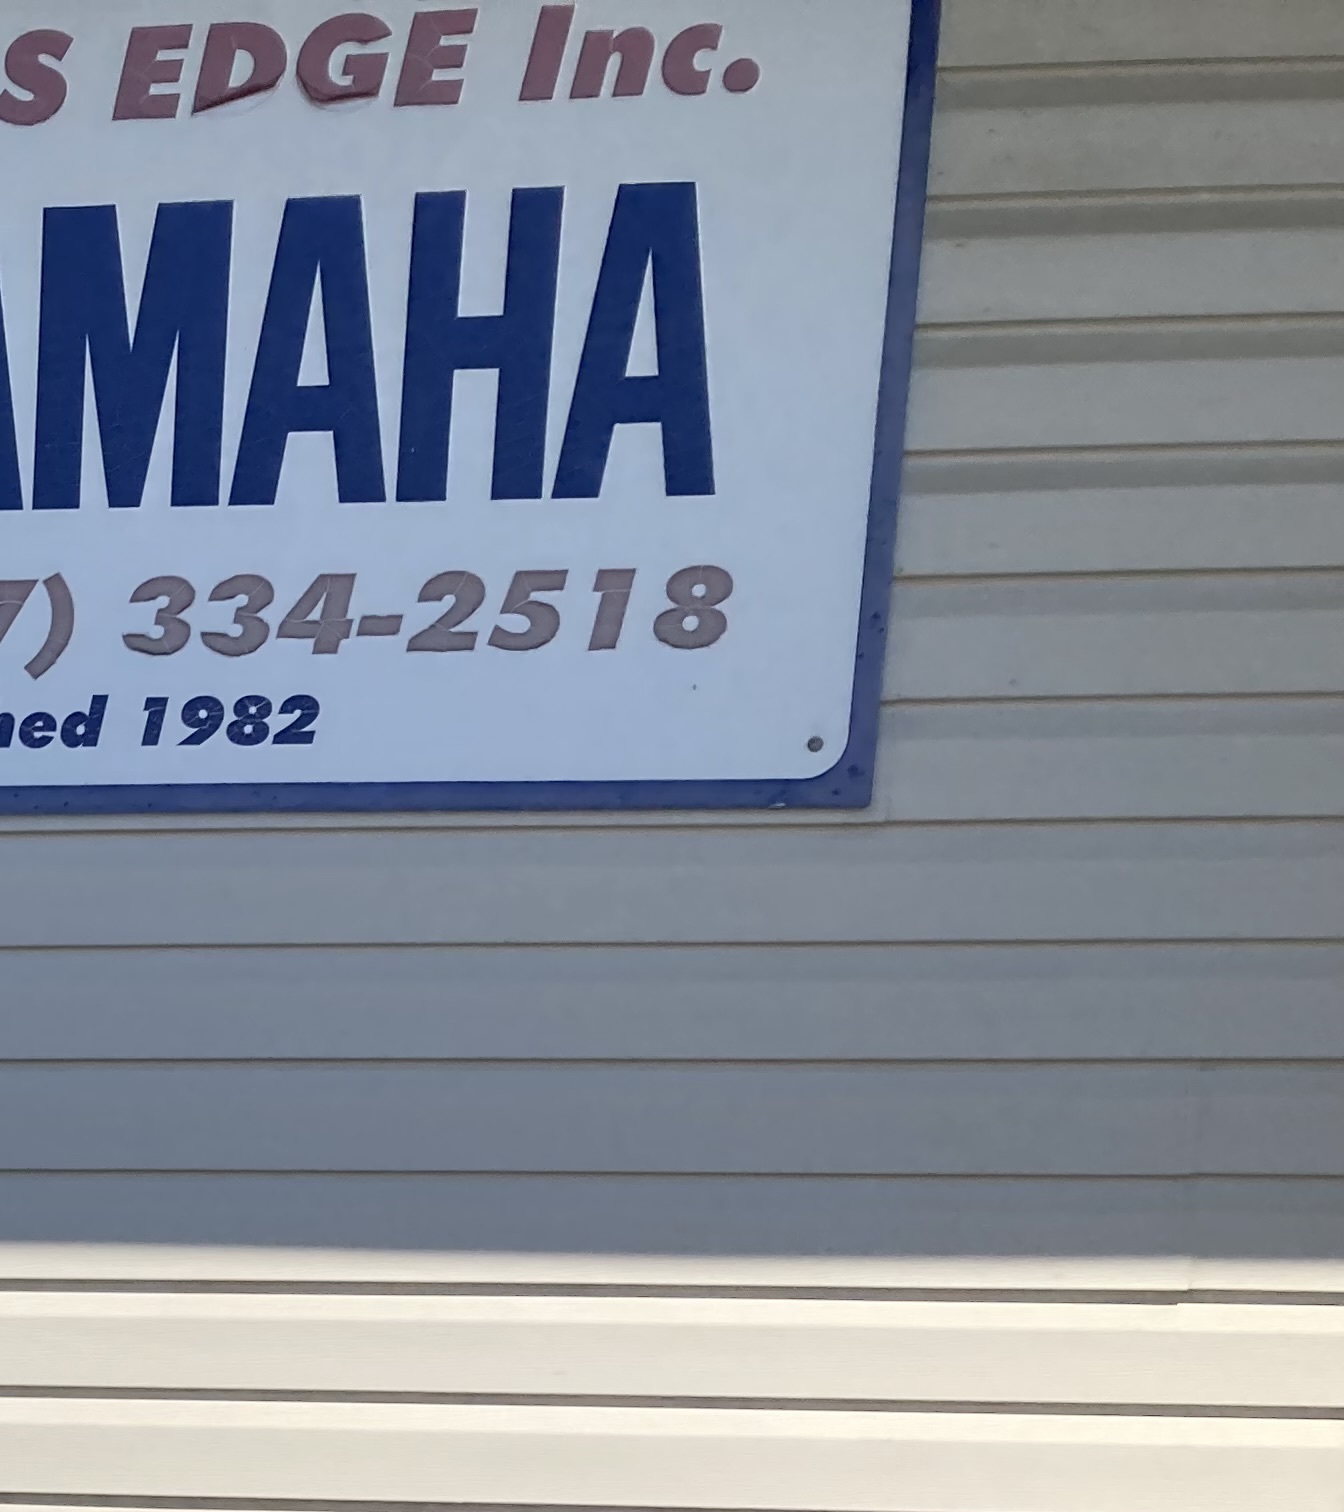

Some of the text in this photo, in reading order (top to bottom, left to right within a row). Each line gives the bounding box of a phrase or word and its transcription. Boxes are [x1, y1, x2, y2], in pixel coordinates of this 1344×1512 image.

[113, 8, 476, 119] EDGE
[519, 5, 760, 101] Inc.
[123, 565, 733, 657] 334-2518
[141, 695, 321, 747] 1982
